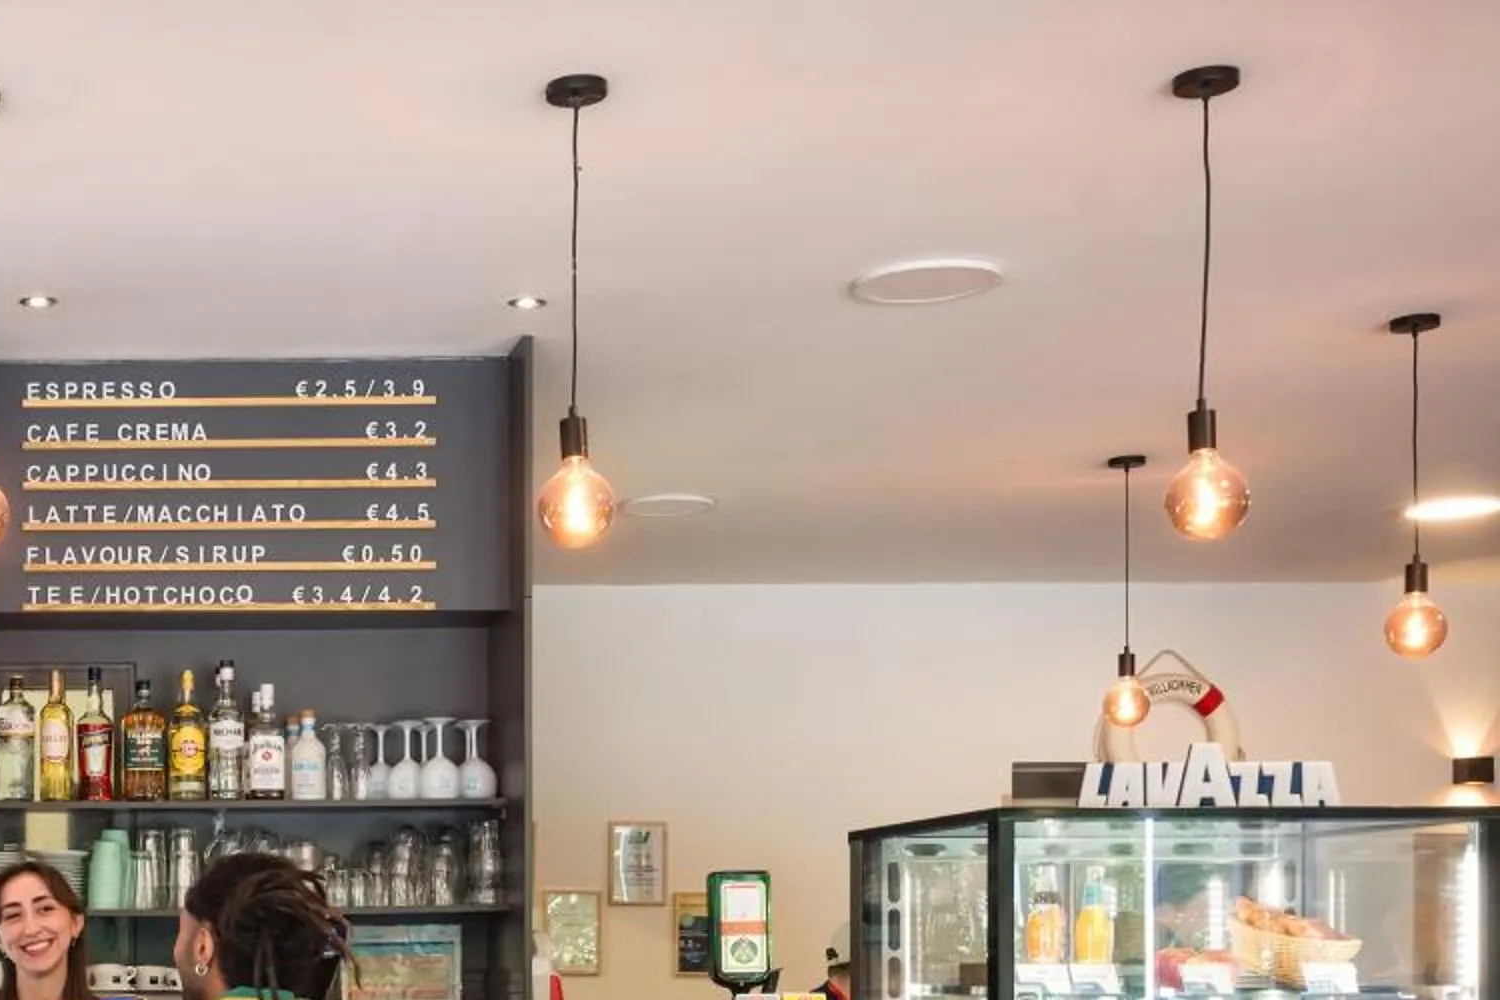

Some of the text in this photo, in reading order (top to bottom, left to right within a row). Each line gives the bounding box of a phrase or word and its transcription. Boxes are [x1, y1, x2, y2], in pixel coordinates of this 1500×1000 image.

[26, 382, 176, 400] ESPRESSO
[26, 421, 428, 442] CAFE CREMA €3.2
[26, 462, 428, 483] CAPPUCCINO €4.3
[28, 502, 430, 523] LATTE/MACCHIATO €4.5
[26, 544, 423, 564] FLAVOUR/SIRUP €0.50
[1078, 742, 1342, 807] LAVAZZA
